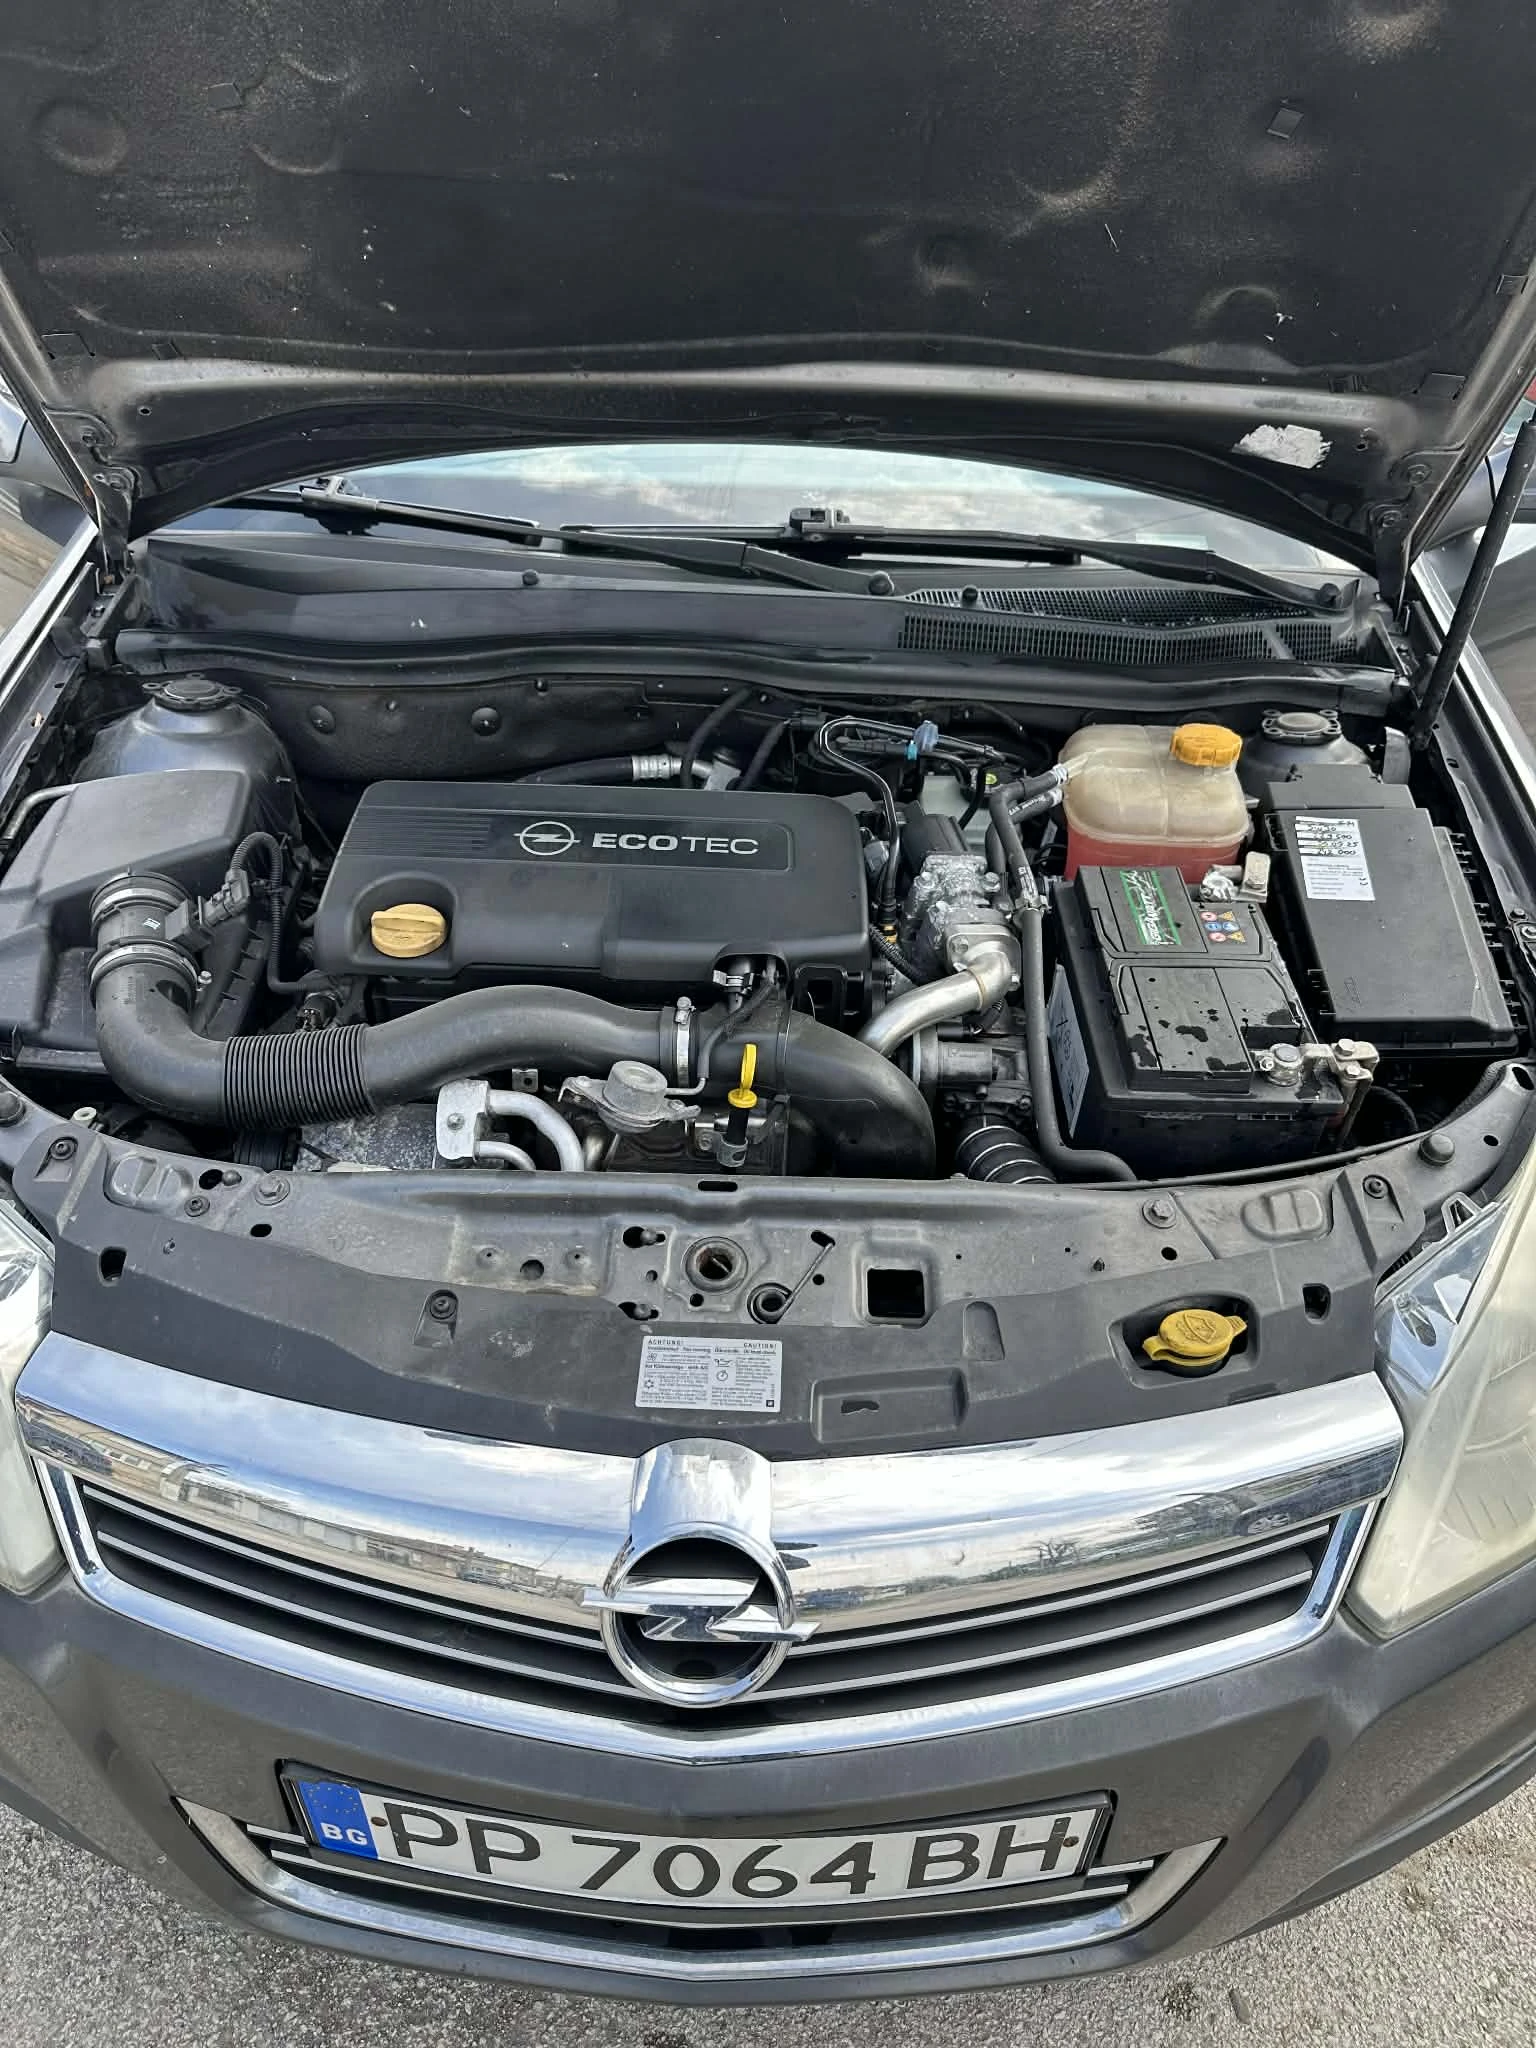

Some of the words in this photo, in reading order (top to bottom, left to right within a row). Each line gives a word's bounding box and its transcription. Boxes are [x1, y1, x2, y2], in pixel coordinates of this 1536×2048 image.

[592, 832, 759, 855] ECOTEC
[320, 1823, 369, 1846] BG
[383, 1802, 541, 1875] PP
[571, 1834, 876, 1898] 7064
[907, 1817, 1071, 1889] BH
